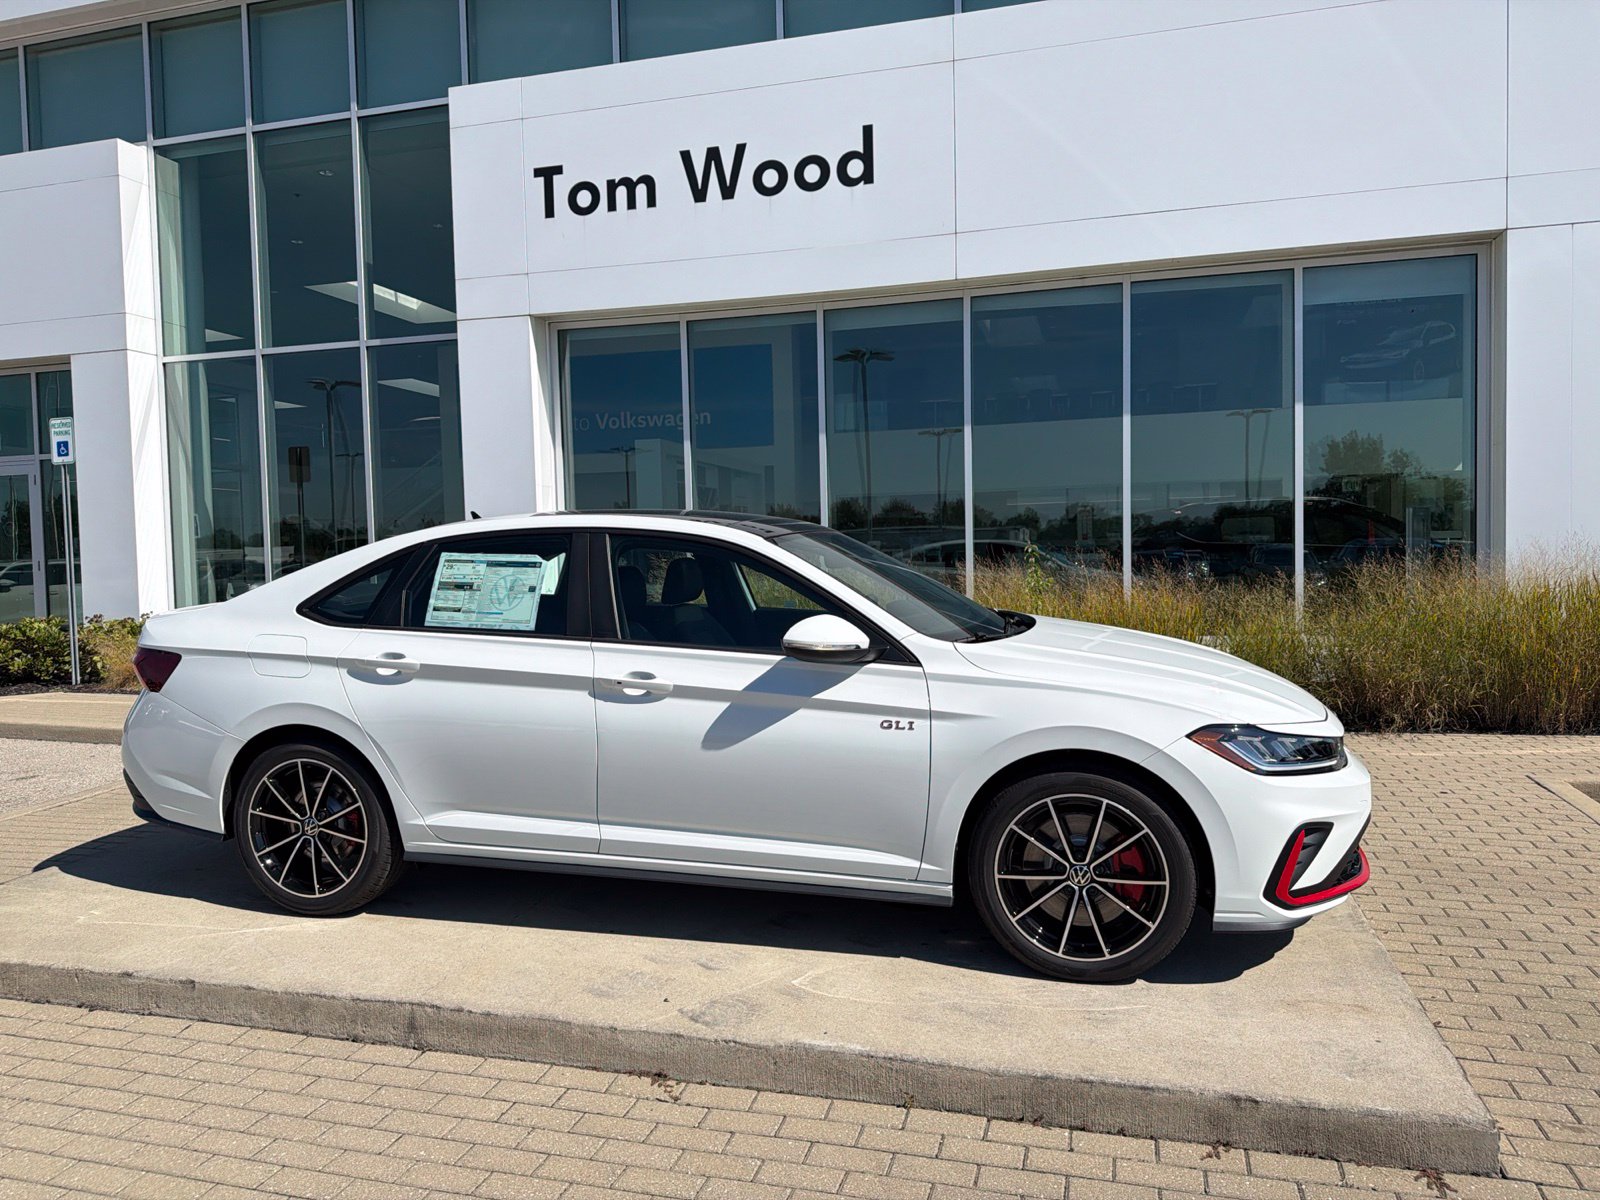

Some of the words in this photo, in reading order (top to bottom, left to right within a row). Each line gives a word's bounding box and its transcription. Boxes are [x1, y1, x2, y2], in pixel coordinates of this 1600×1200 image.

[533, 165, 657, 219] Tom
[679, 124, 875, 204] Wood
[880, 720, 915, 731] GLI
[1069, 865, 1091, 886] VW
